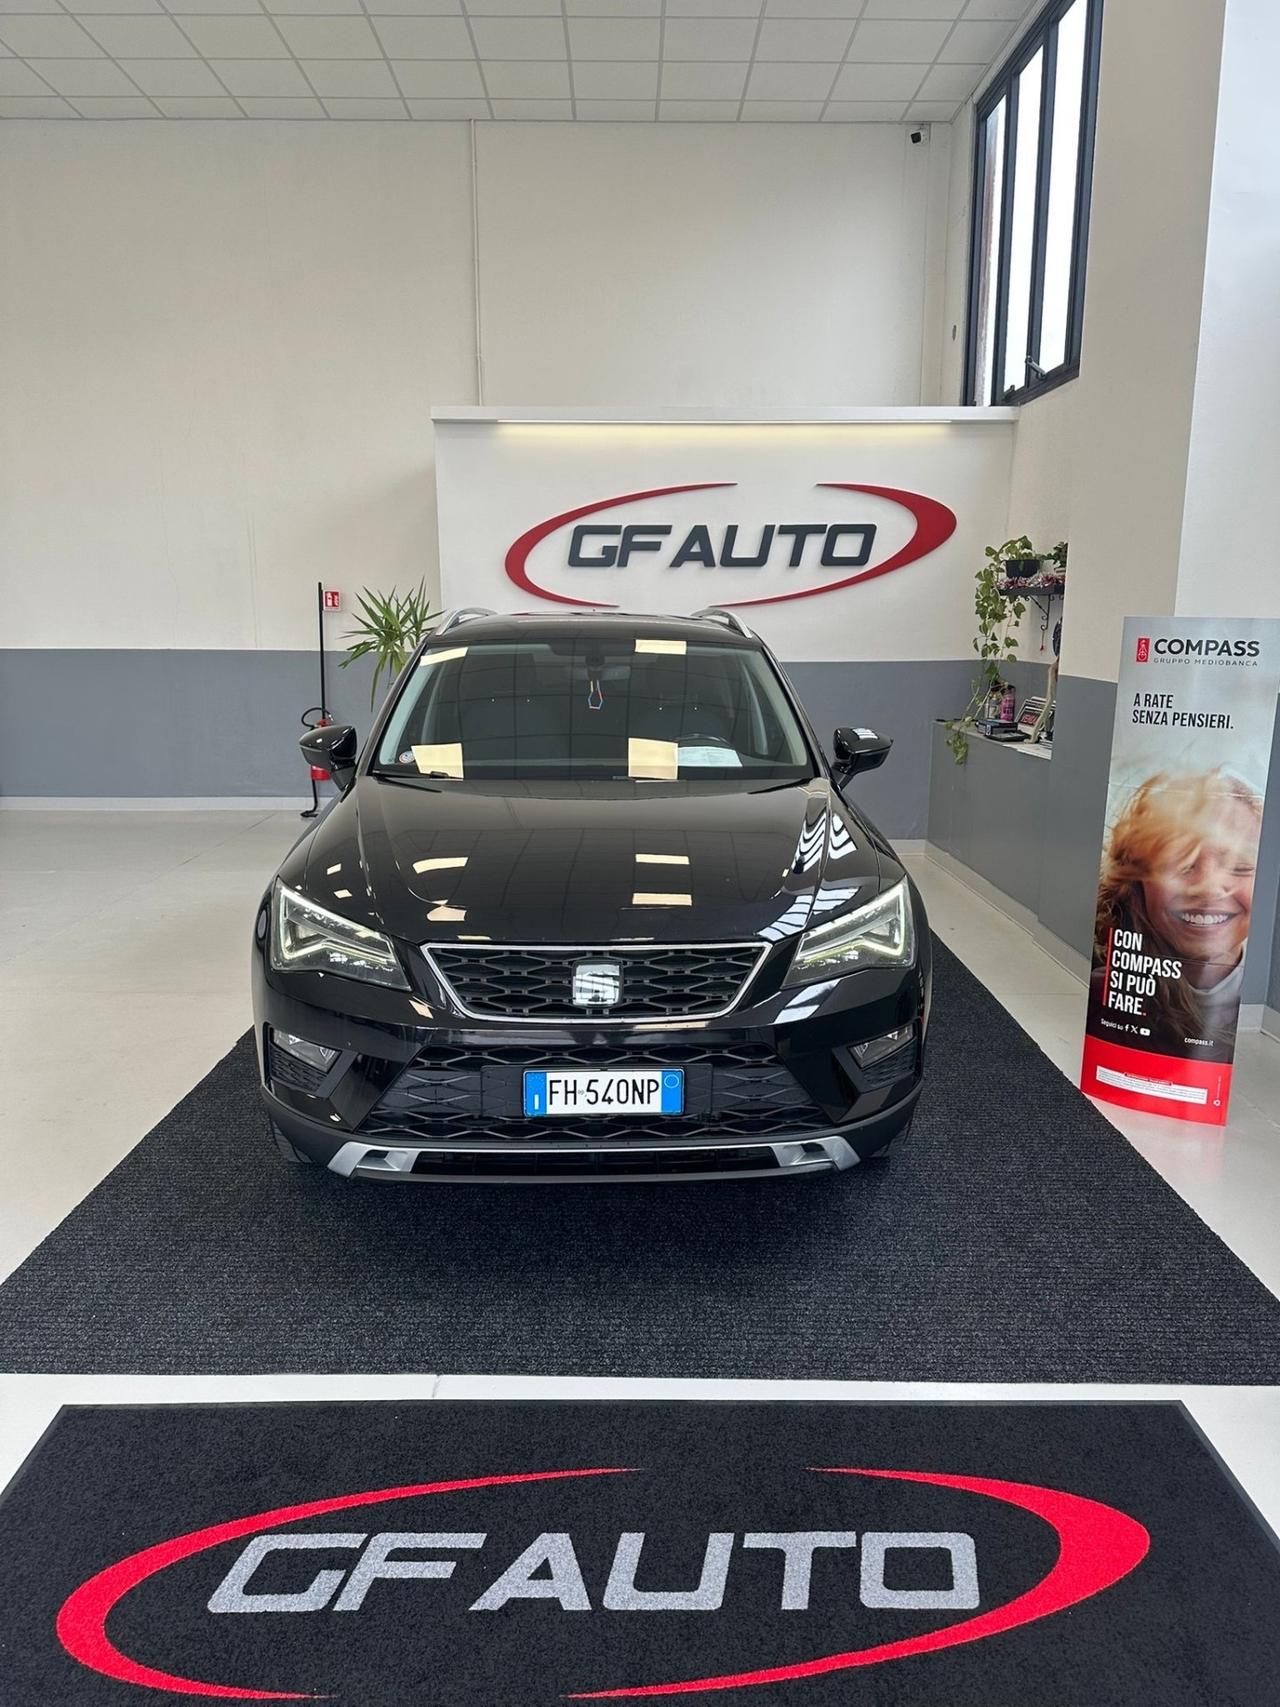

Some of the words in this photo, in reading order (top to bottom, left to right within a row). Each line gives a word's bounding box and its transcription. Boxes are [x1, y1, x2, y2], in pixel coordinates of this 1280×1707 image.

[1154, 638, 1260, 657] COMPASS
[1153, 657, 1191, 665] GRUPPO
[1194, 658, 1258, 667] MEDIOBANCA
[1133, 693, 1141, 707] A
[1144, 693, 1174, 709] RATE
[1132, 709, 1168, 726] SENZA
[1172, 712, 1234, 729] PENSIERI.
[1114, 929, 1143, 951] CON
[1111, 950, 1182, 979] COMPASS
[1109, 970, 1122, 990] SI
[1126, 974, 1156, 997] PUÒ
[1108, 990, 1147, 1017] FARE.
[1184, 1037, 1214, 1047] compass.it
